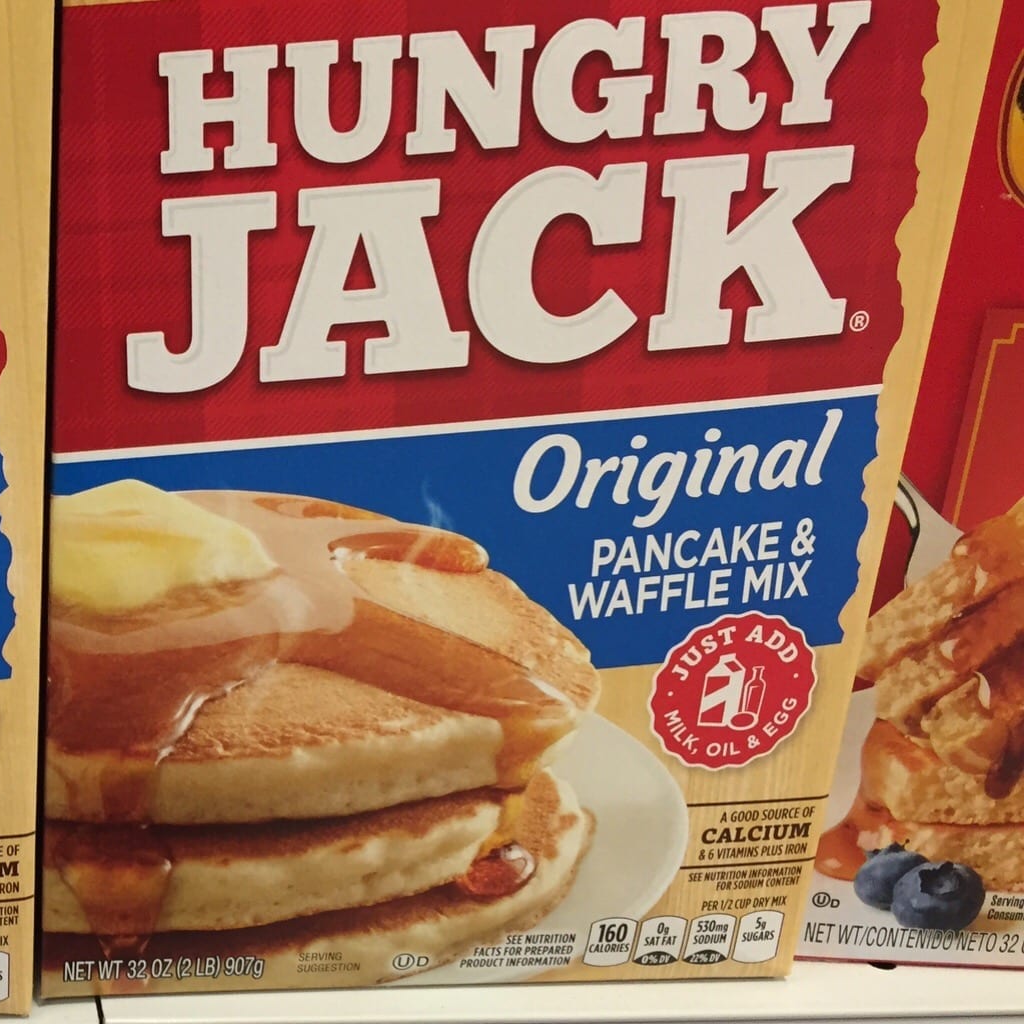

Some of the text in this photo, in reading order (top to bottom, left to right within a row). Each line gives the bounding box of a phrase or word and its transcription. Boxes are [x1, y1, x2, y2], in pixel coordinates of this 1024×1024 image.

[158, 1, 872, 174] HUNGRY
[126, 145, 855, 393] JACK
[513, 409, 843, 528] Original
[591, 518, 816, 577] PANCAKE &
[568, 560, 812, 620] WAFFLE MIX
[672, 625, 799, 681] JUST ADD
[6, 845, 20, 856] OF
[701, 822, 812, 845] CALCIUM
[804, 922, 1020, 954] NET WT/CONTENIDO NETO 32
